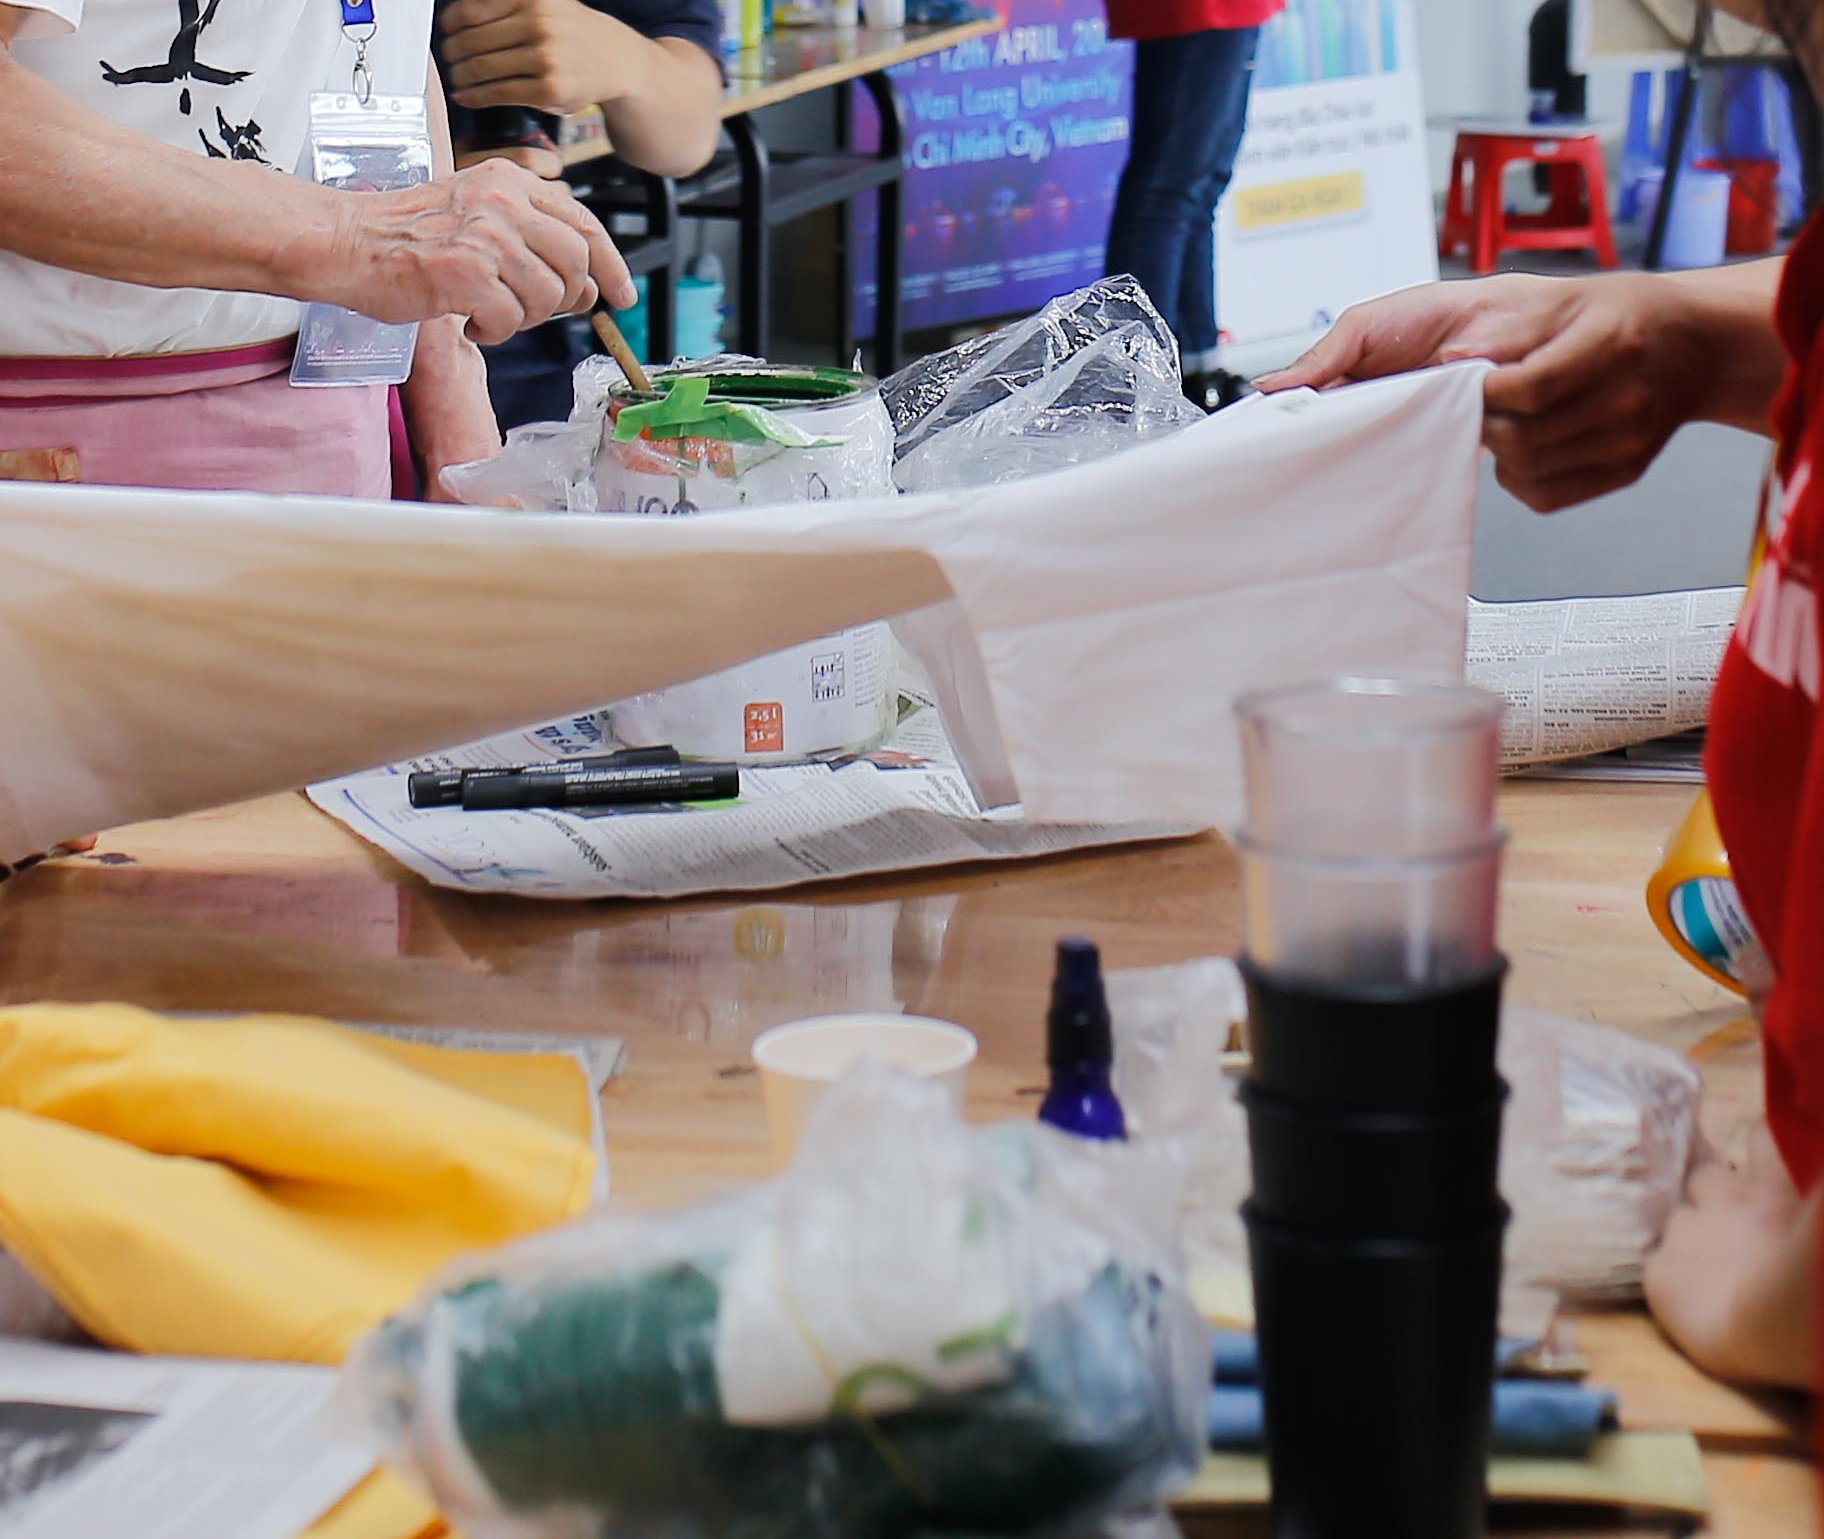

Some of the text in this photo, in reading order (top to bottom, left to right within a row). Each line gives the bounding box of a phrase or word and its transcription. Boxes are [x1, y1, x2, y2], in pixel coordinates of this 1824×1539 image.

[910, 66, 1123, 122] Van Lang University
[911, 130, 952, 171] Chi
